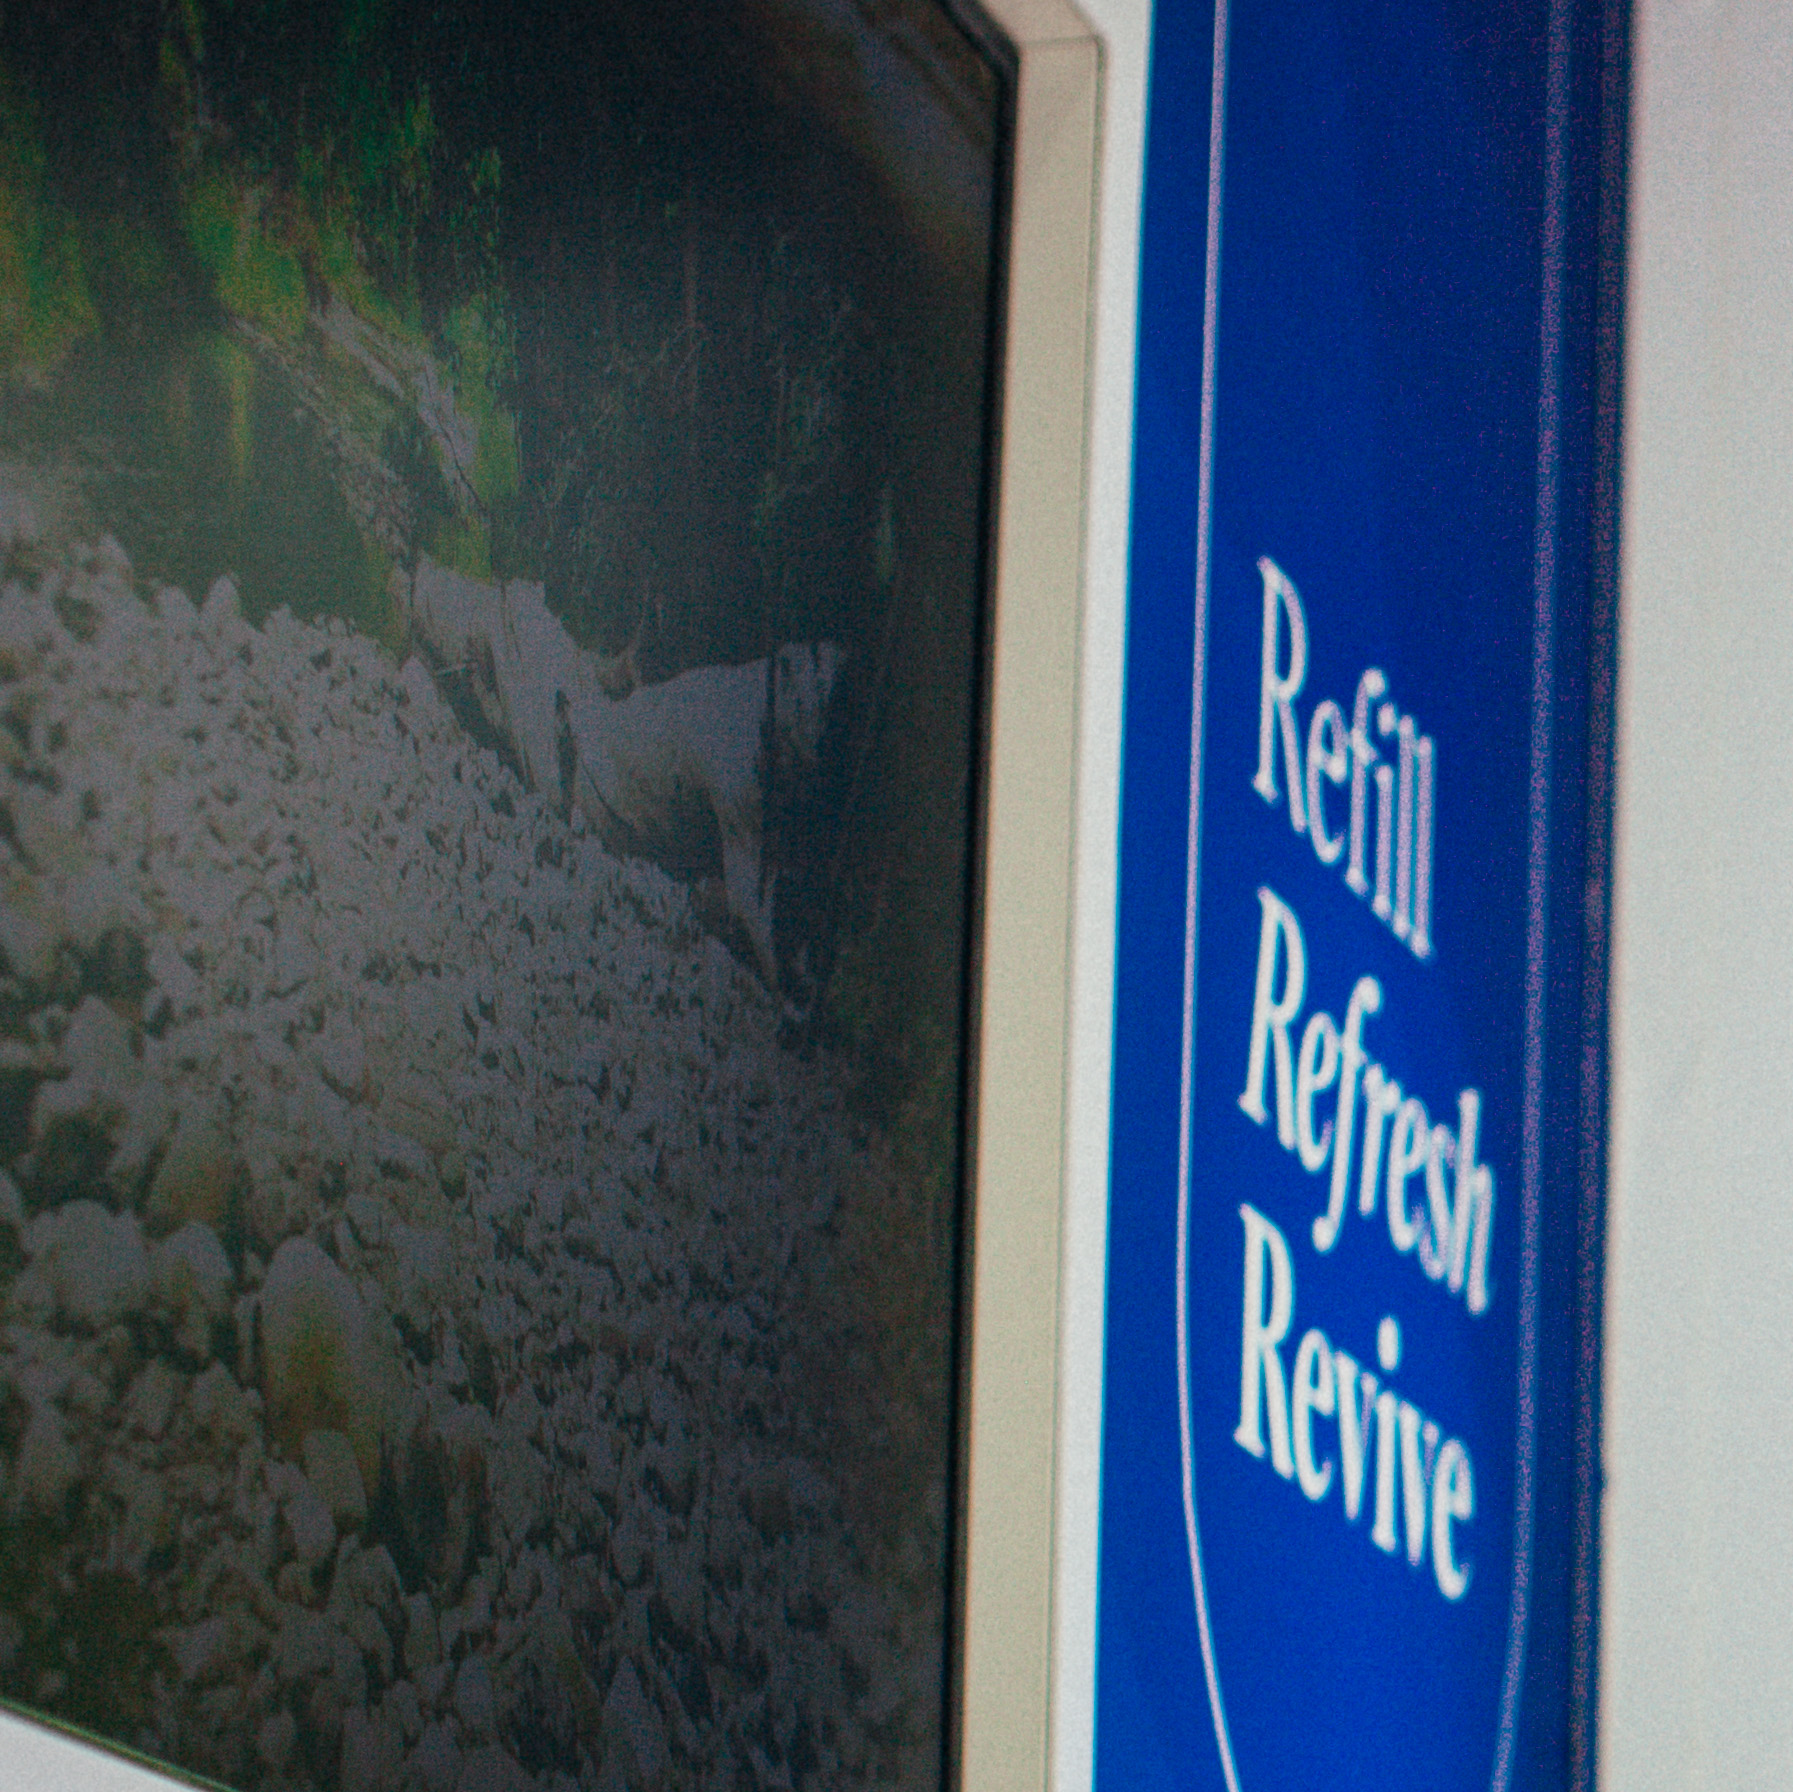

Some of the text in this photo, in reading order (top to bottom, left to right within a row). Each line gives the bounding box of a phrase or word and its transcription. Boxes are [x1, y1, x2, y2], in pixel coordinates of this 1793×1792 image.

[1252, 554, 1437, 961] Refill
[1238, 885, 1495, 1316] Refresh
[1233, 1203, 1474, 1601] Revive
